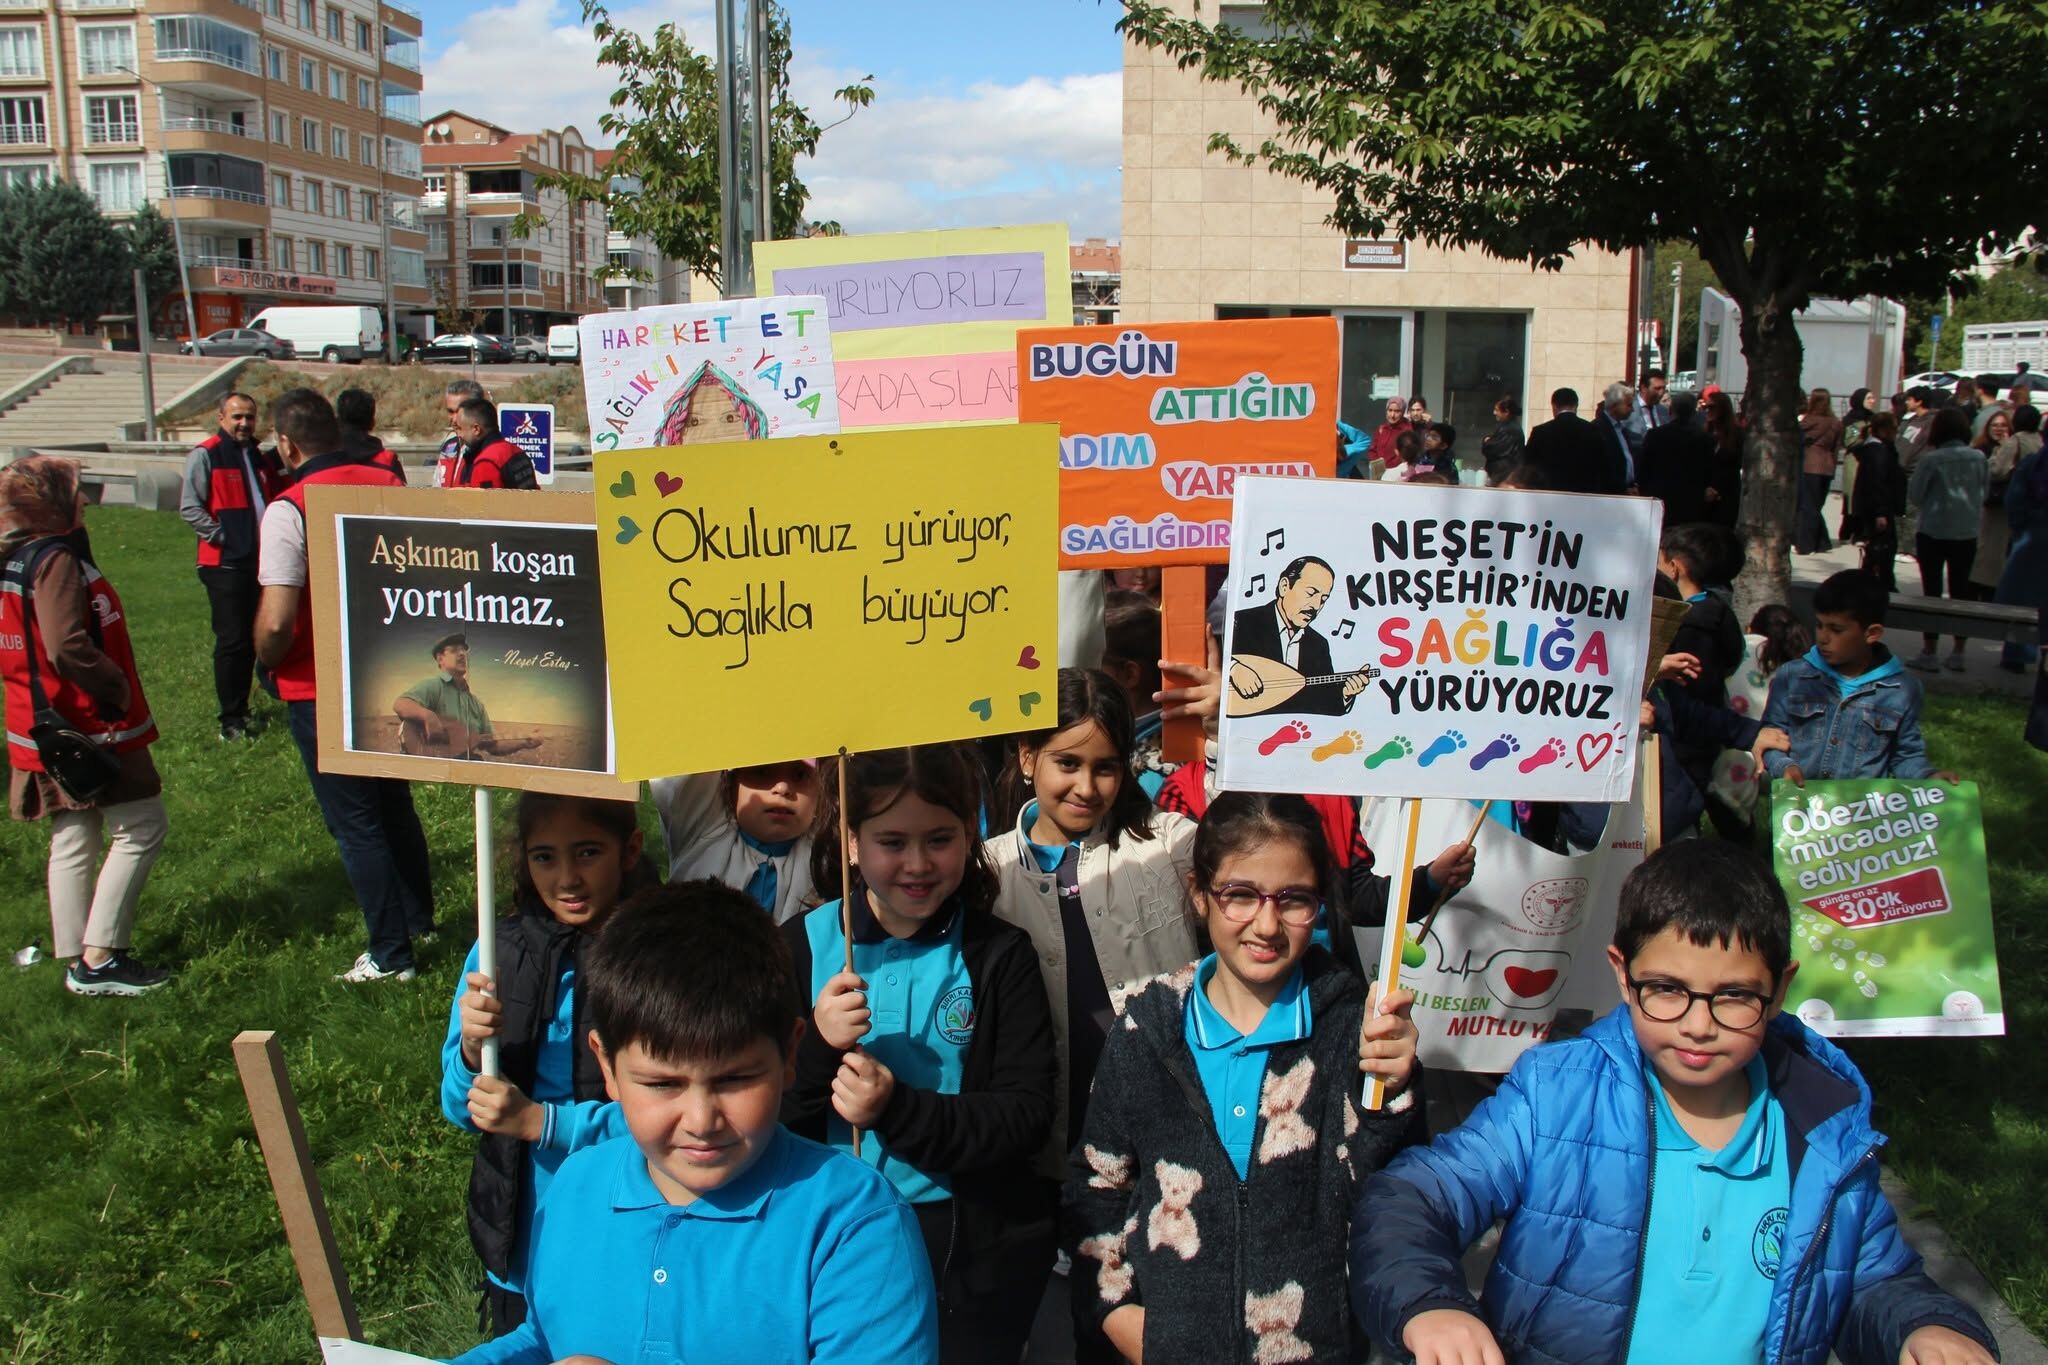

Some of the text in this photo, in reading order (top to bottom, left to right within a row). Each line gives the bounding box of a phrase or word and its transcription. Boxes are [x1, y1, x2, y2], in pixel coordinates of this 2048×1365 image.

[784, 268, 1024, 318] ÜRÜYORUZ
[602, 309, 815, 350] HAREKET ET
[1033, 332, 1173, 377] BUGÜN
[596, 354, 679, 450] SAĞLIKLI
[753, 348, 821, 420] YAŞA
[1154, 376, 1307, 420] ATTIĞIN
[653, 506, 1011, 564] Okulumuz yürüyor,
[1066, 514, 1230, 551] SAĞLIĞIDIR
[1372, 519, 1583, 569] NEŞET'İN
[370, 534, 576, 582] Aşkınan koşan
[381, 582, 564, 627] yorulmaz.
[1346, 565, 1629, 620] KIRŞEHİR'İNDEN
[667, 575, 1008, 670] Sağlıkla büyüyor.
[1378, 608, 1609, 676] SAĞLIĞA
[1379, 670, 1613, 720] YÜRÜYORUZ
[1782, 787, 1945, 838] Obezite ile
[1790, 811, 1940, 865] mücadele
[1799, 834, 1939, 891] ediyoruz!
[1819, 887, 1878, 909] günde en az
[1881, 899, 1943, 920] yürüyoruz
[1431, 995, 1491, 1012] BESLEN
[1447, 1015, 1527, 1037] MUTLU
